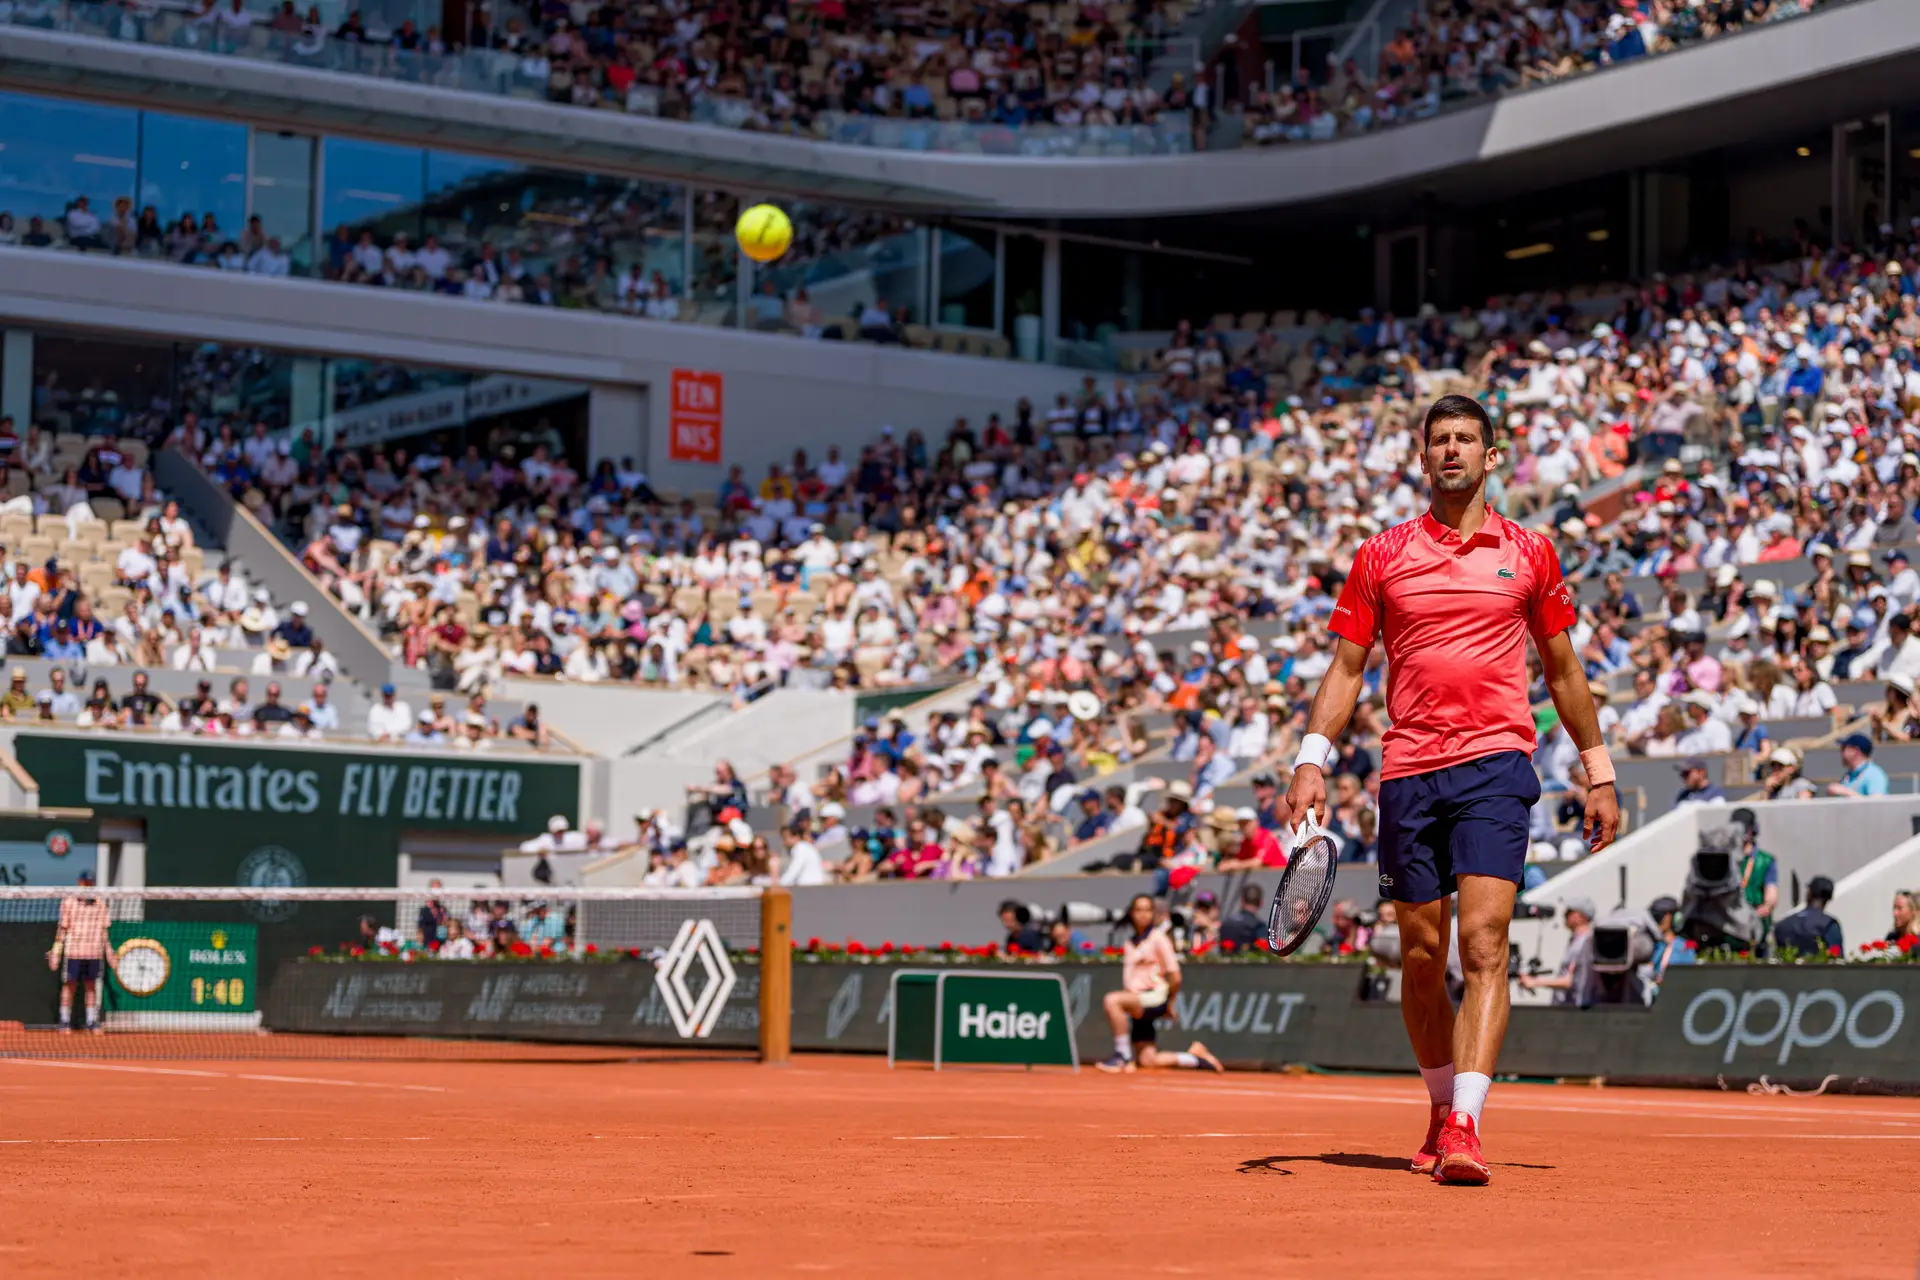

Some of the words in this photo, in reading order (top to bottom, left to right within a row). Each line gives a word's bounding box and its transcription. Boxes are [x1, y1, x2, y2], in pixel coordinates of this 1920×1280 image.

[677, 380, 716, 409] TEN
[677, 424, 715, 451] NIS
[84, 748, 321, 813] Emirates
[338, 763, 399, 818] FLY
[403, 765, 523, 822] BETTER
[189, 949, 247, 965] ROLEX
[191, 976, 245, 1006] 1:40
[958, 1002, 1052, 1040] Haier
[1152, 990, 1306, 1035] NAULT
[1681, 987, 1905, 1066] oppo
